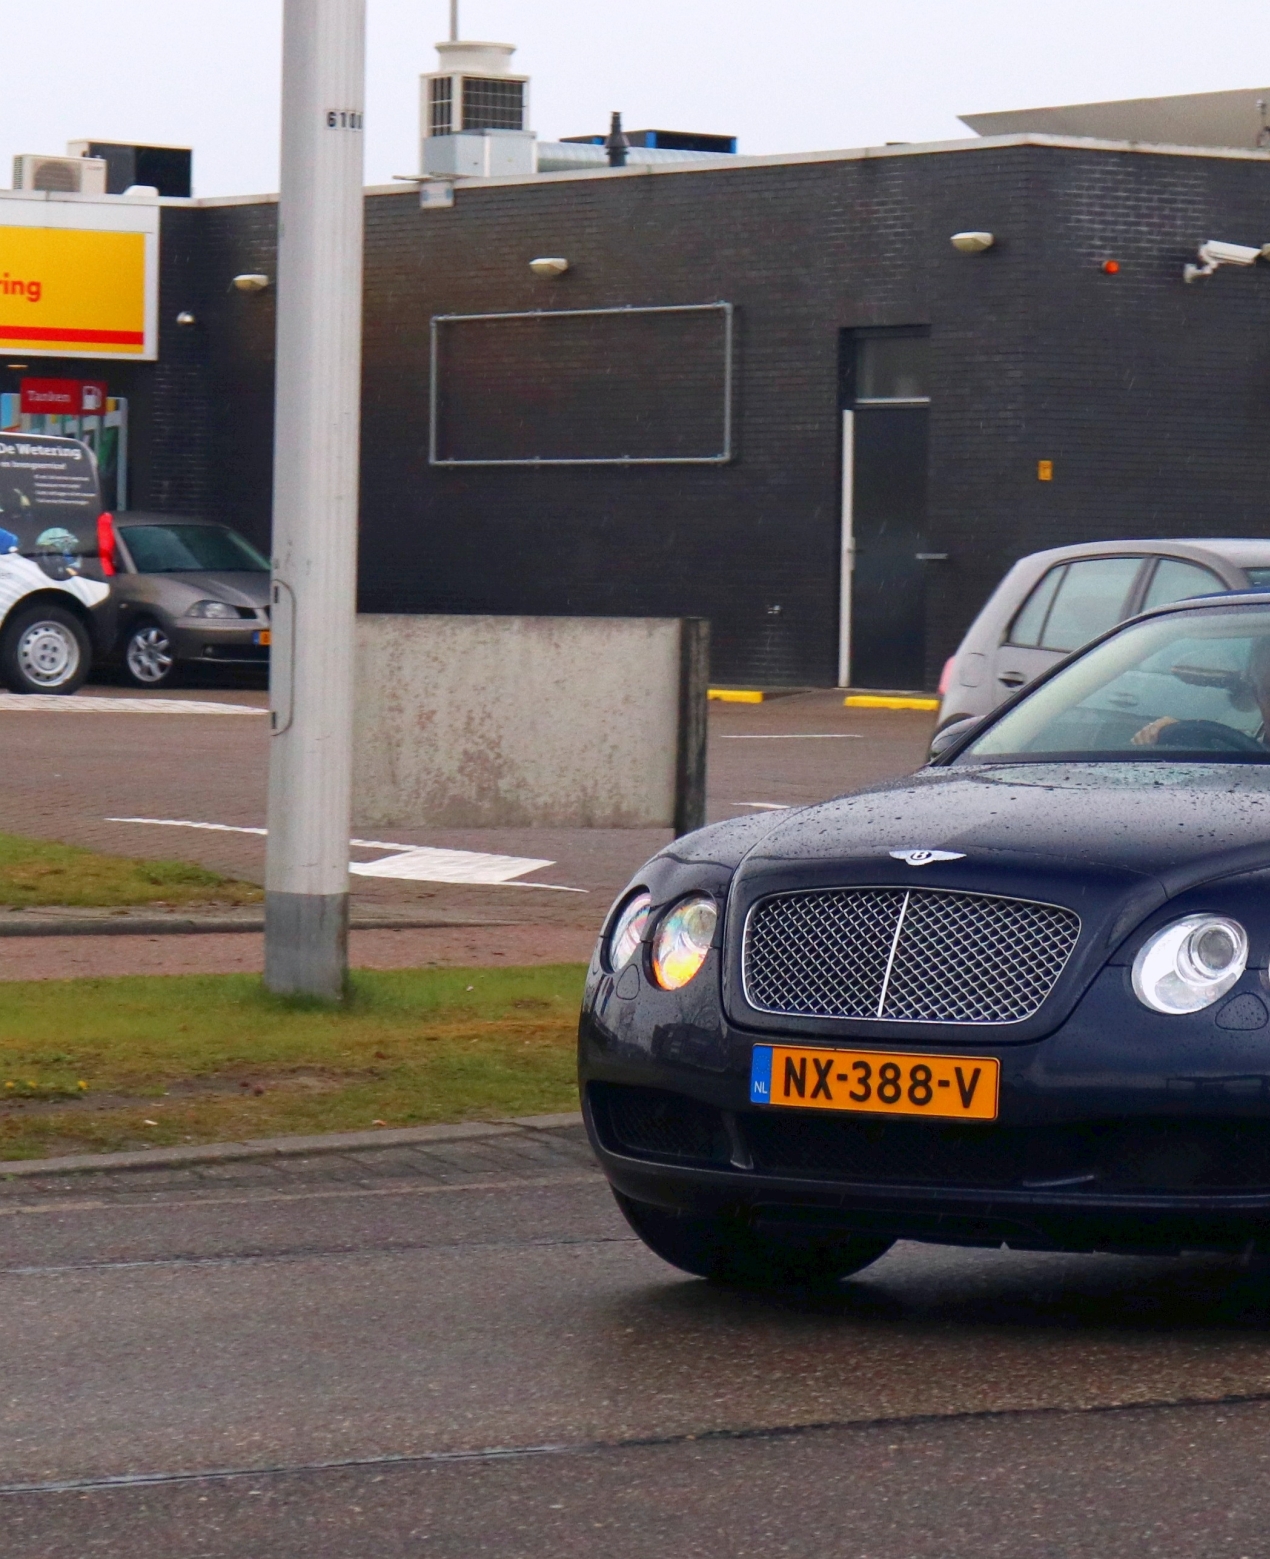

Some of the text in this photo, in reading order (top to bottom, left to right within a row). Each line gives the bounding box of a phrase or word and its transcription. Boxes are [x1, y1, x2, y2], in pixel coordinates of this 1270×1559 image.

[27, 389, 71, 403] Tanken
[15, 443, 82, 460] Wetering
[754, 1080, 768, 1094] NL
[783, 1056, 982, 1109] NX-388-V
